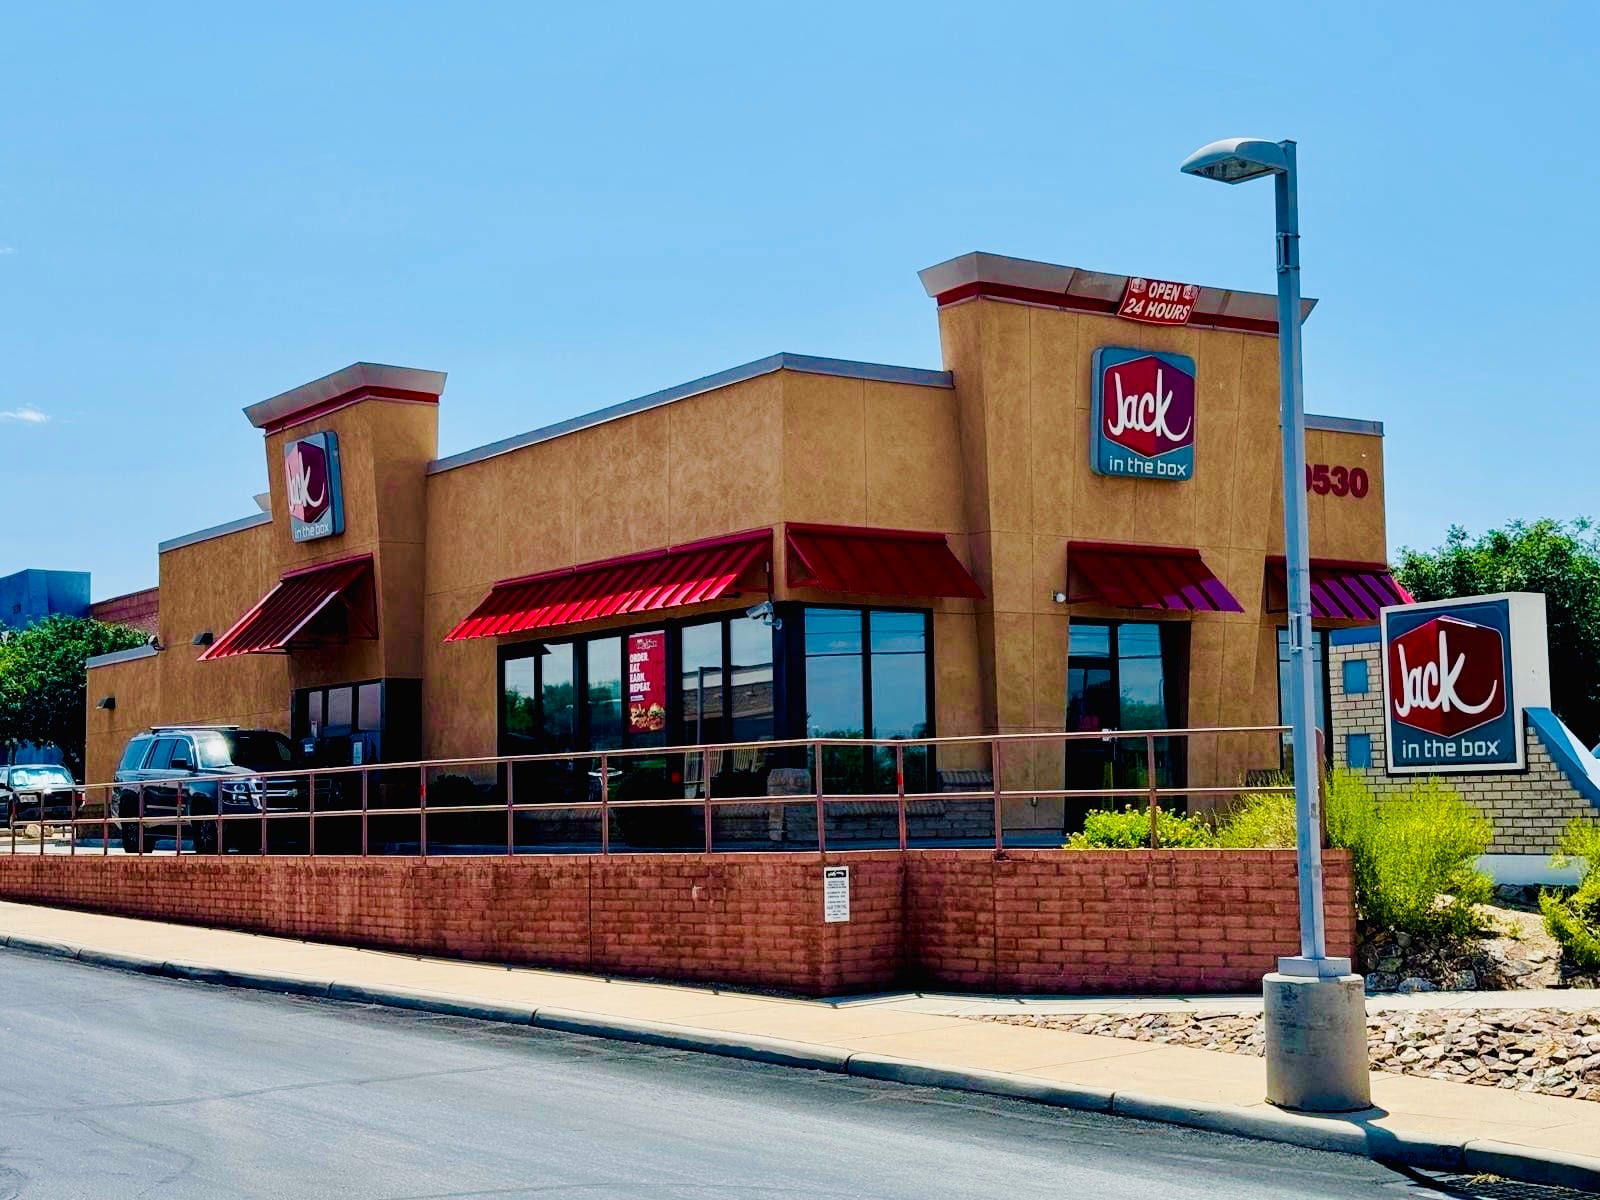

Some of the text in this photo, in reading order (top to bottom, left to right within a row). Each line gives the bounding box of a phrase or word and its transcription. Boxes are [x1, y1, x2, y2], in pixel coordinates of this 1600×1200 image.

[1148, 282, 1182, 301] OPEN
[1124, 298, 1191, 320] 24 HOURS
[1107, 368, 1192, 442] Jack
[1109, 456, 1188, 476] in the box
[294, 521, 329, 539] in the box
[1395, 630, 1498, 717] Jack
[1402, 737, 1500, 759] in the box
